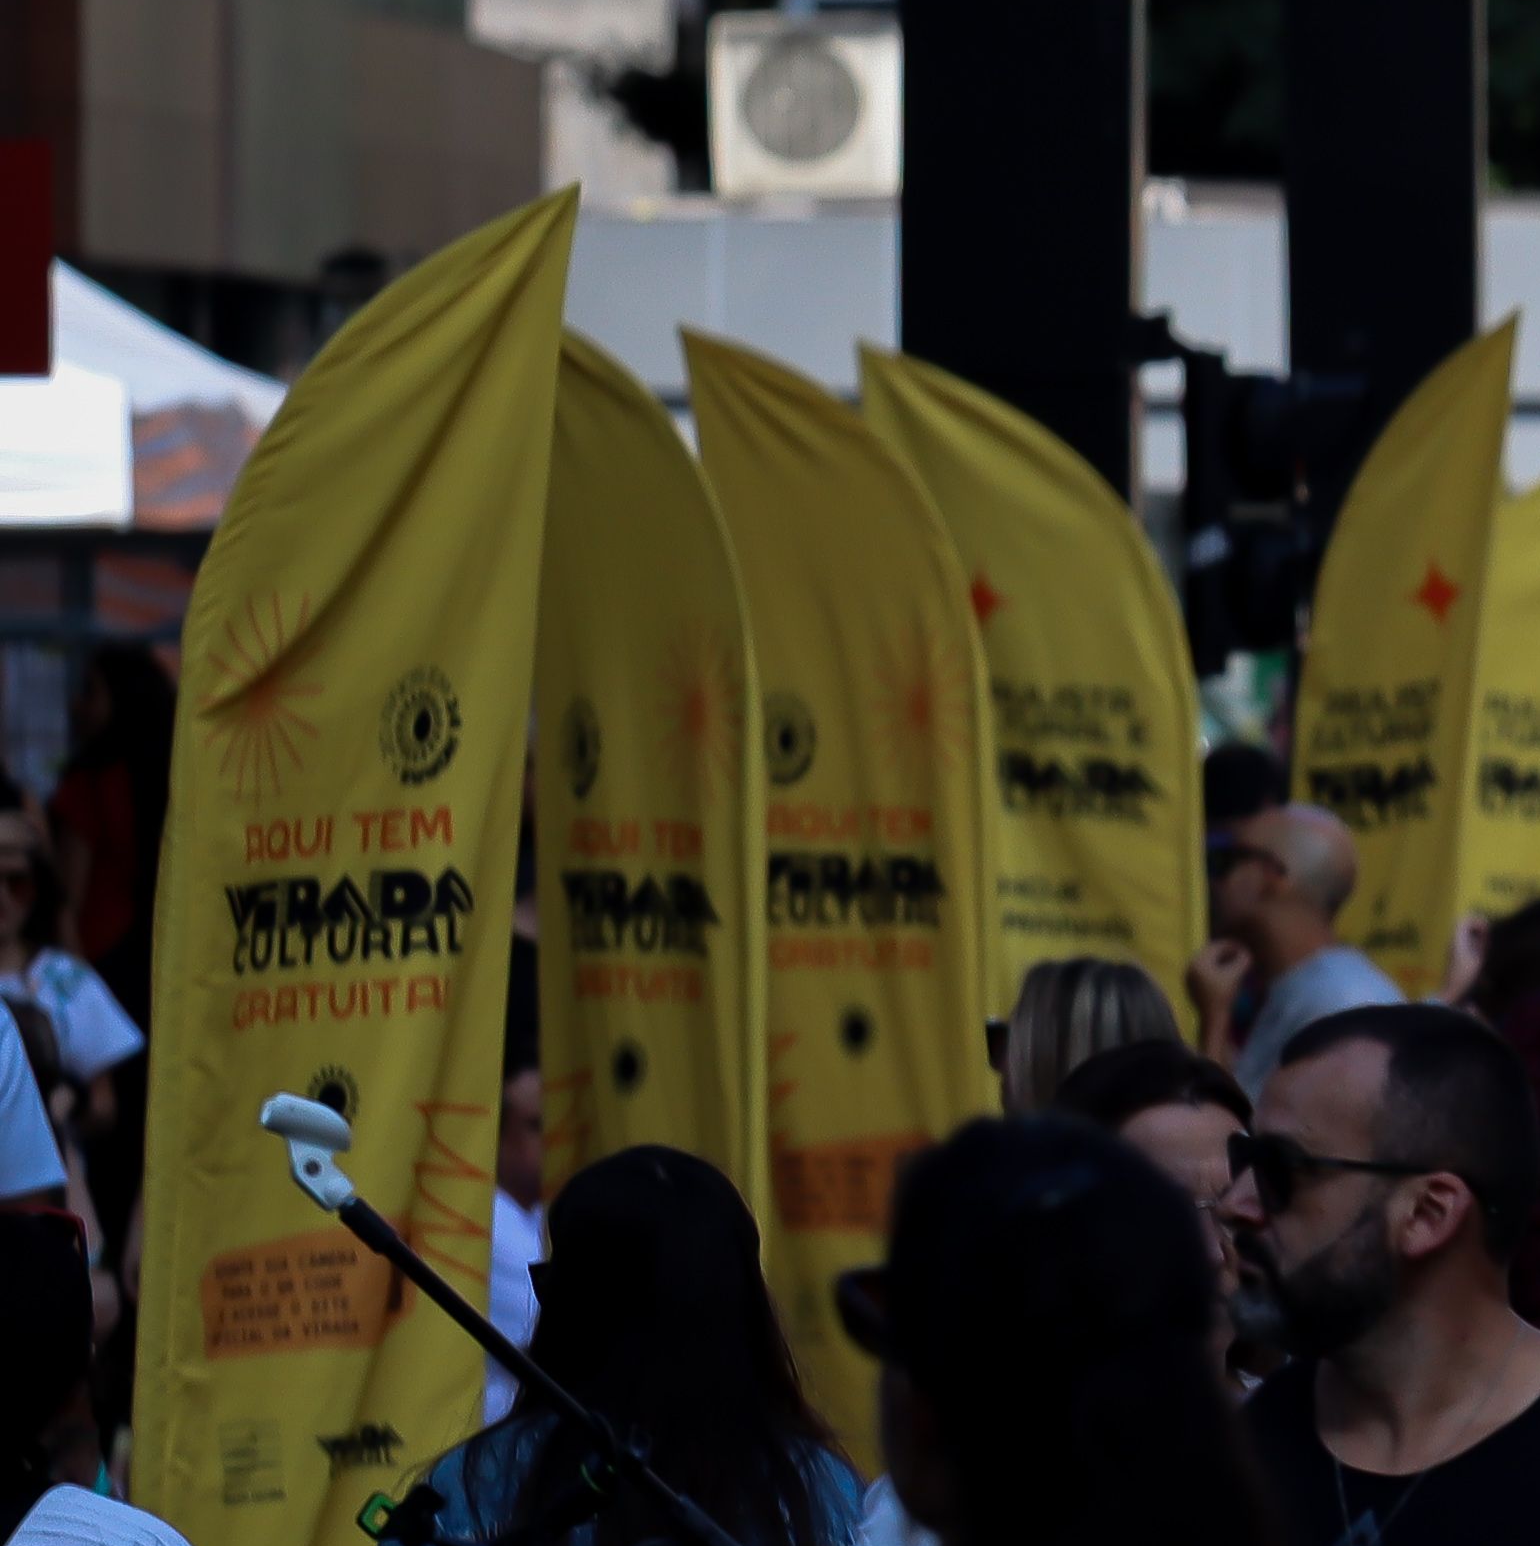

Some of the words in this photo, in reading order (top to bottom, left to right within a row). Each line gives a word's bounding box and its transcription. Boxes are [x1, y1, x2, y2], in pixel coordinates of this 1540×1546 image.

[245, 814, 334, 864] AQUI
[353, 805, 454, 854] TEM
[224, 861, 475, 936] VIRADA
[233, 915, 462, 976] CULTURAL
